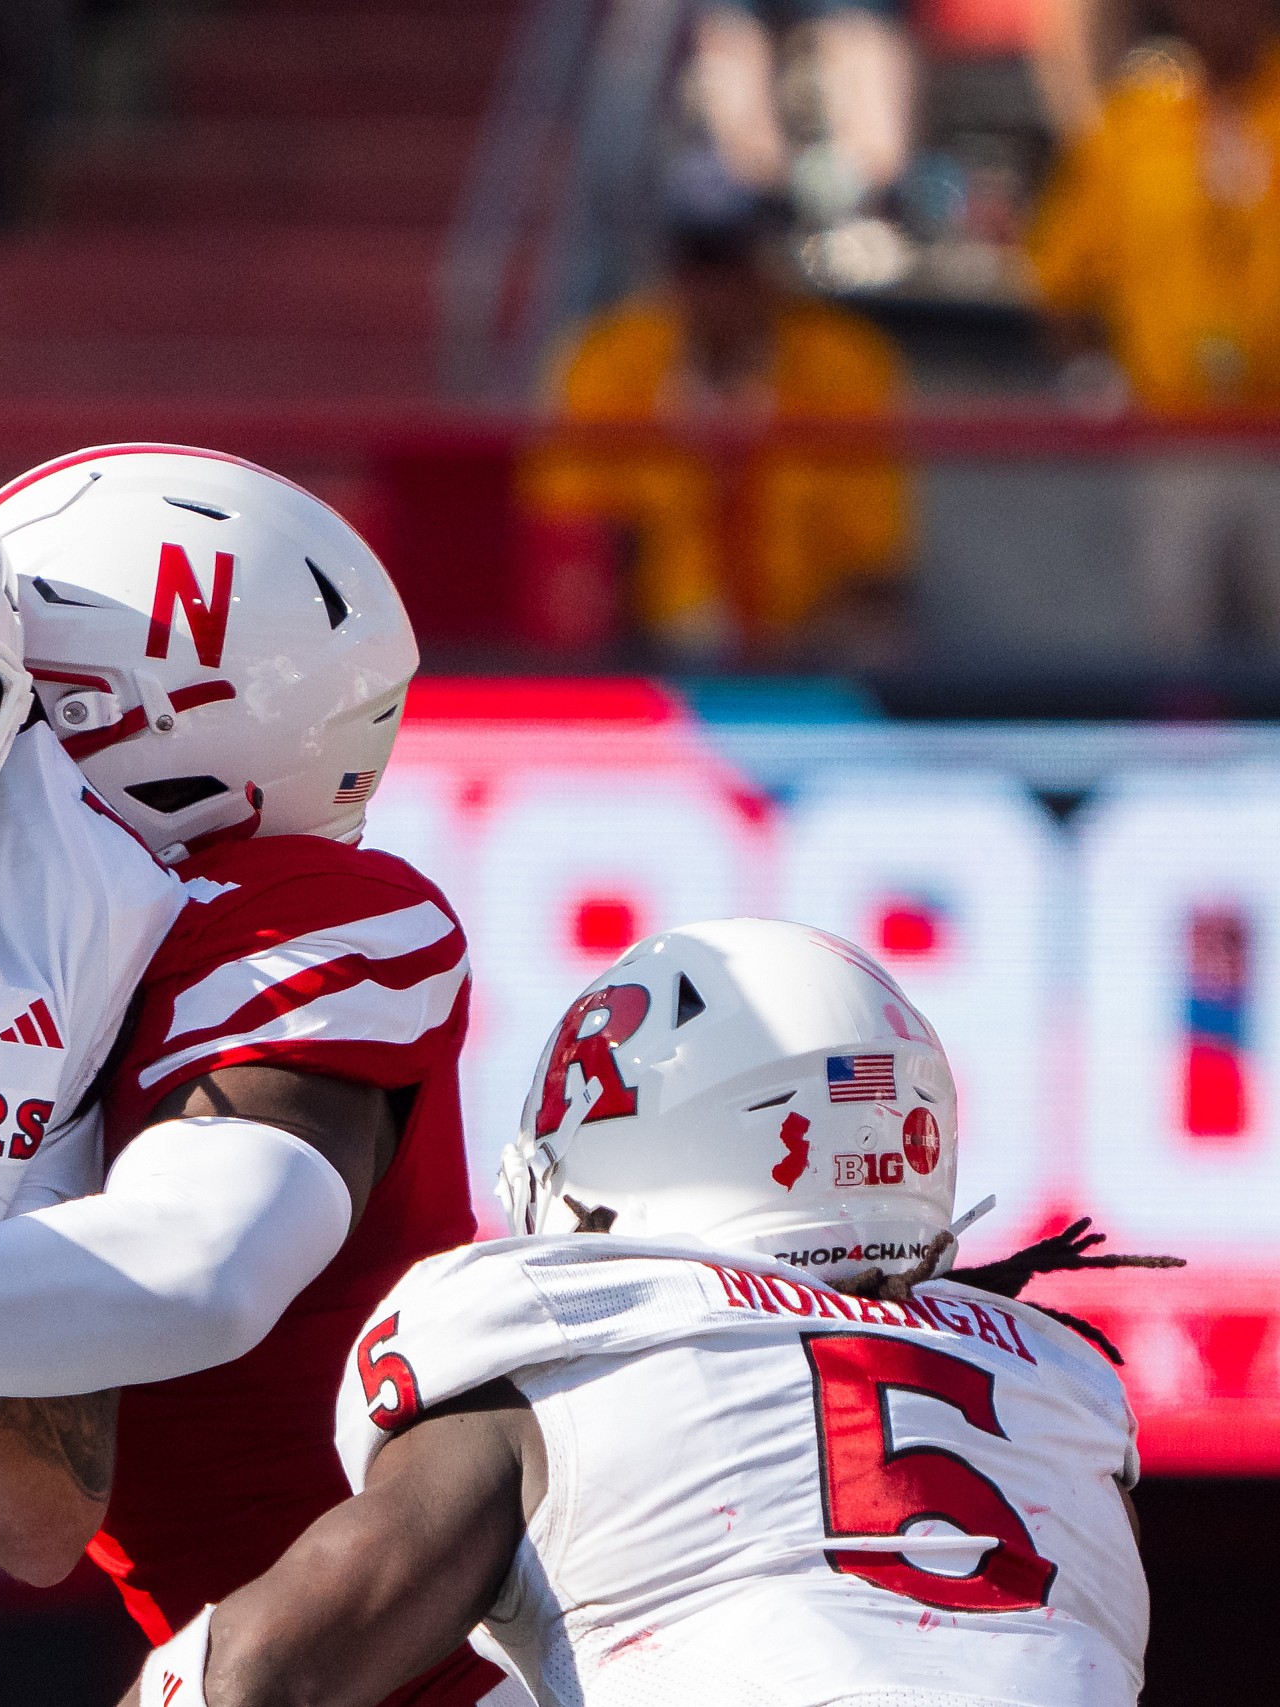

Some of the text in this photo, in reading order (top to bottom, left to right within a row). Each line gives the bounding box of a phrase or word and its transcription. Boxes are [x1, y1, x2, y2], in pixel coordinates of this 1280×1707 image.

[145, 542, 235, 669] N
[534, 982, 652, 1141] R
[356, 1311, 424, 1432] 5
[700, 1261, 1038, 1367] MONANGAI
[799, 1331, 1058, 1613] 5
